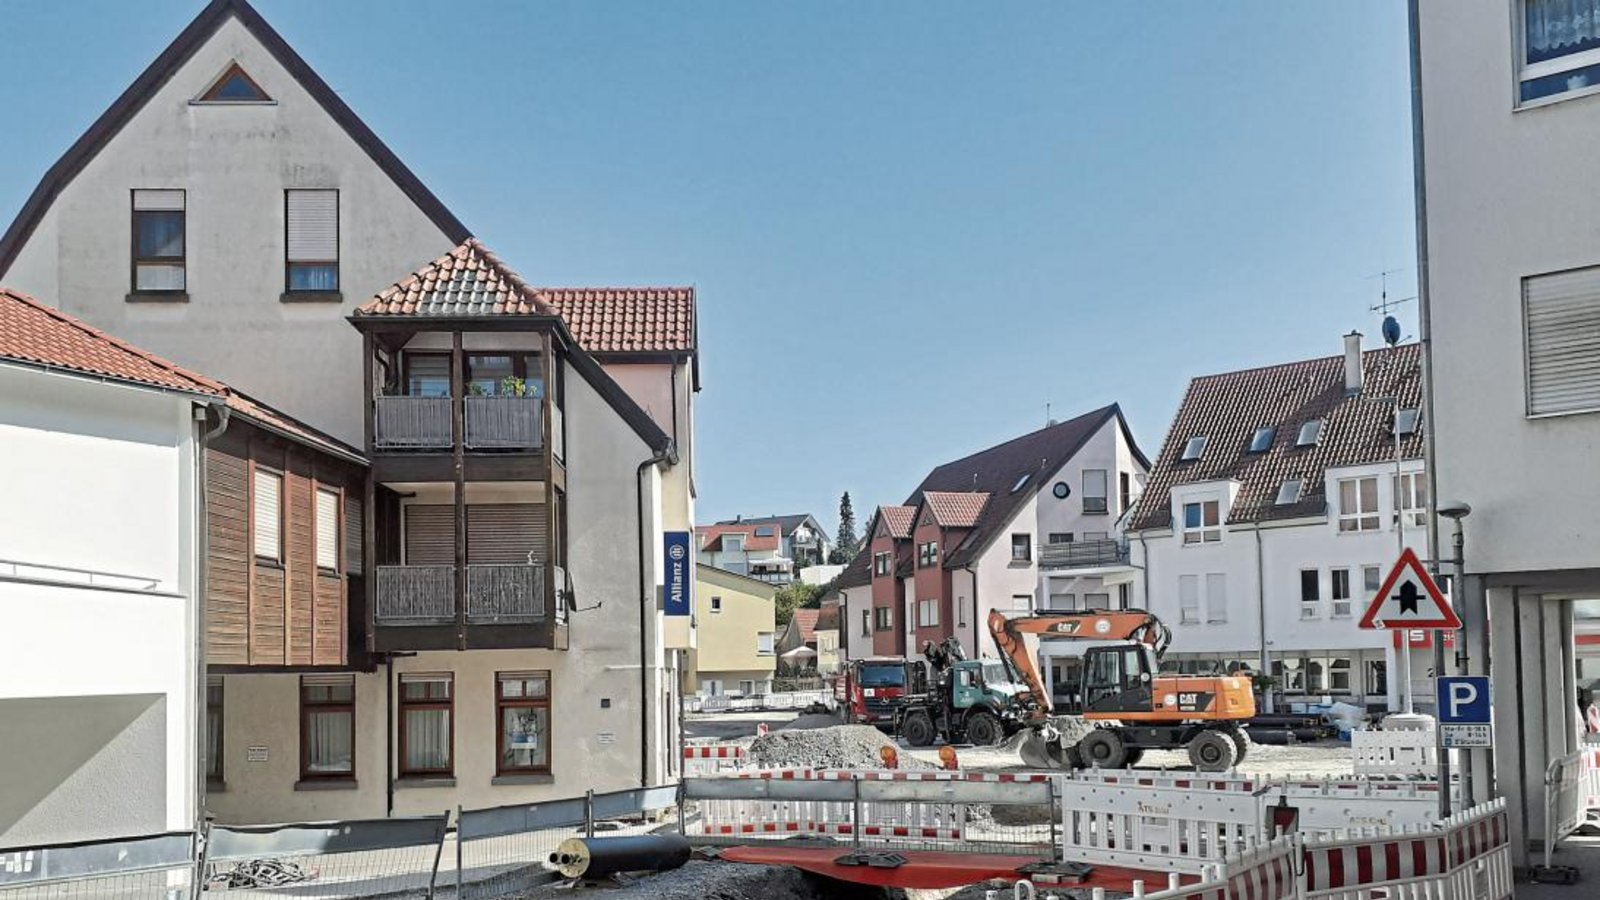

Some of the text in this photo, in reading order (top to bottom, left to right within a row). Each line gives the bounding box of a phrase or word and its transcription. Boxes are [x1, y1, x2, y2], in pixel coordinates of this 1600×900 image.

[671, 562, 682, 603] Allianz
[1057, 622, 1072, 632] CAT
[1179, 693, 1197, 704] CAT
[1449, 682, 1477, 717] P
